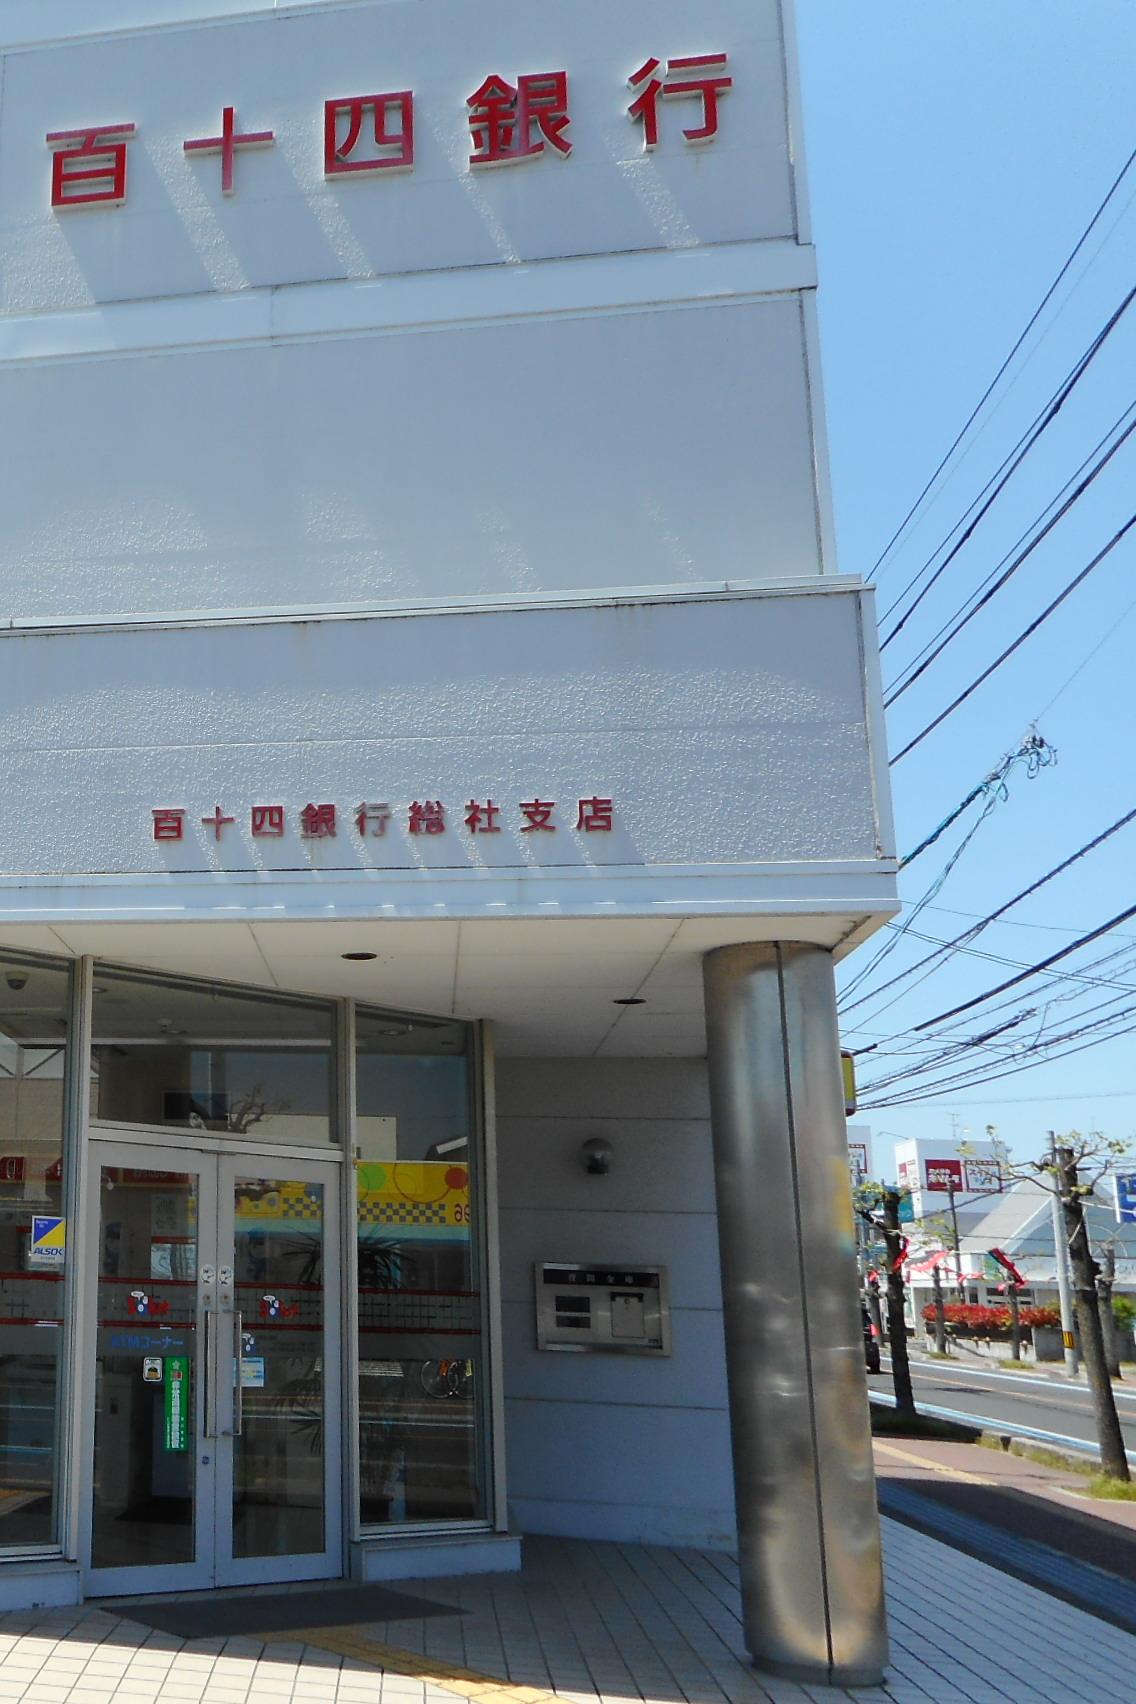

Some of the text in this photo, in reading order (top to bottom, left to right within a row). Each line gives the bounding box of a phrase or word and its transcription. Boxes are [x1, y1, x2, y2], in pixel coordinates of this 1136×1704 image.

[46, 53, 732, 209] 百十四銀行
[151, 796, 614, 842] 百十四銀行総社支店
[33, 1247, 64, 1256] ALSOK
